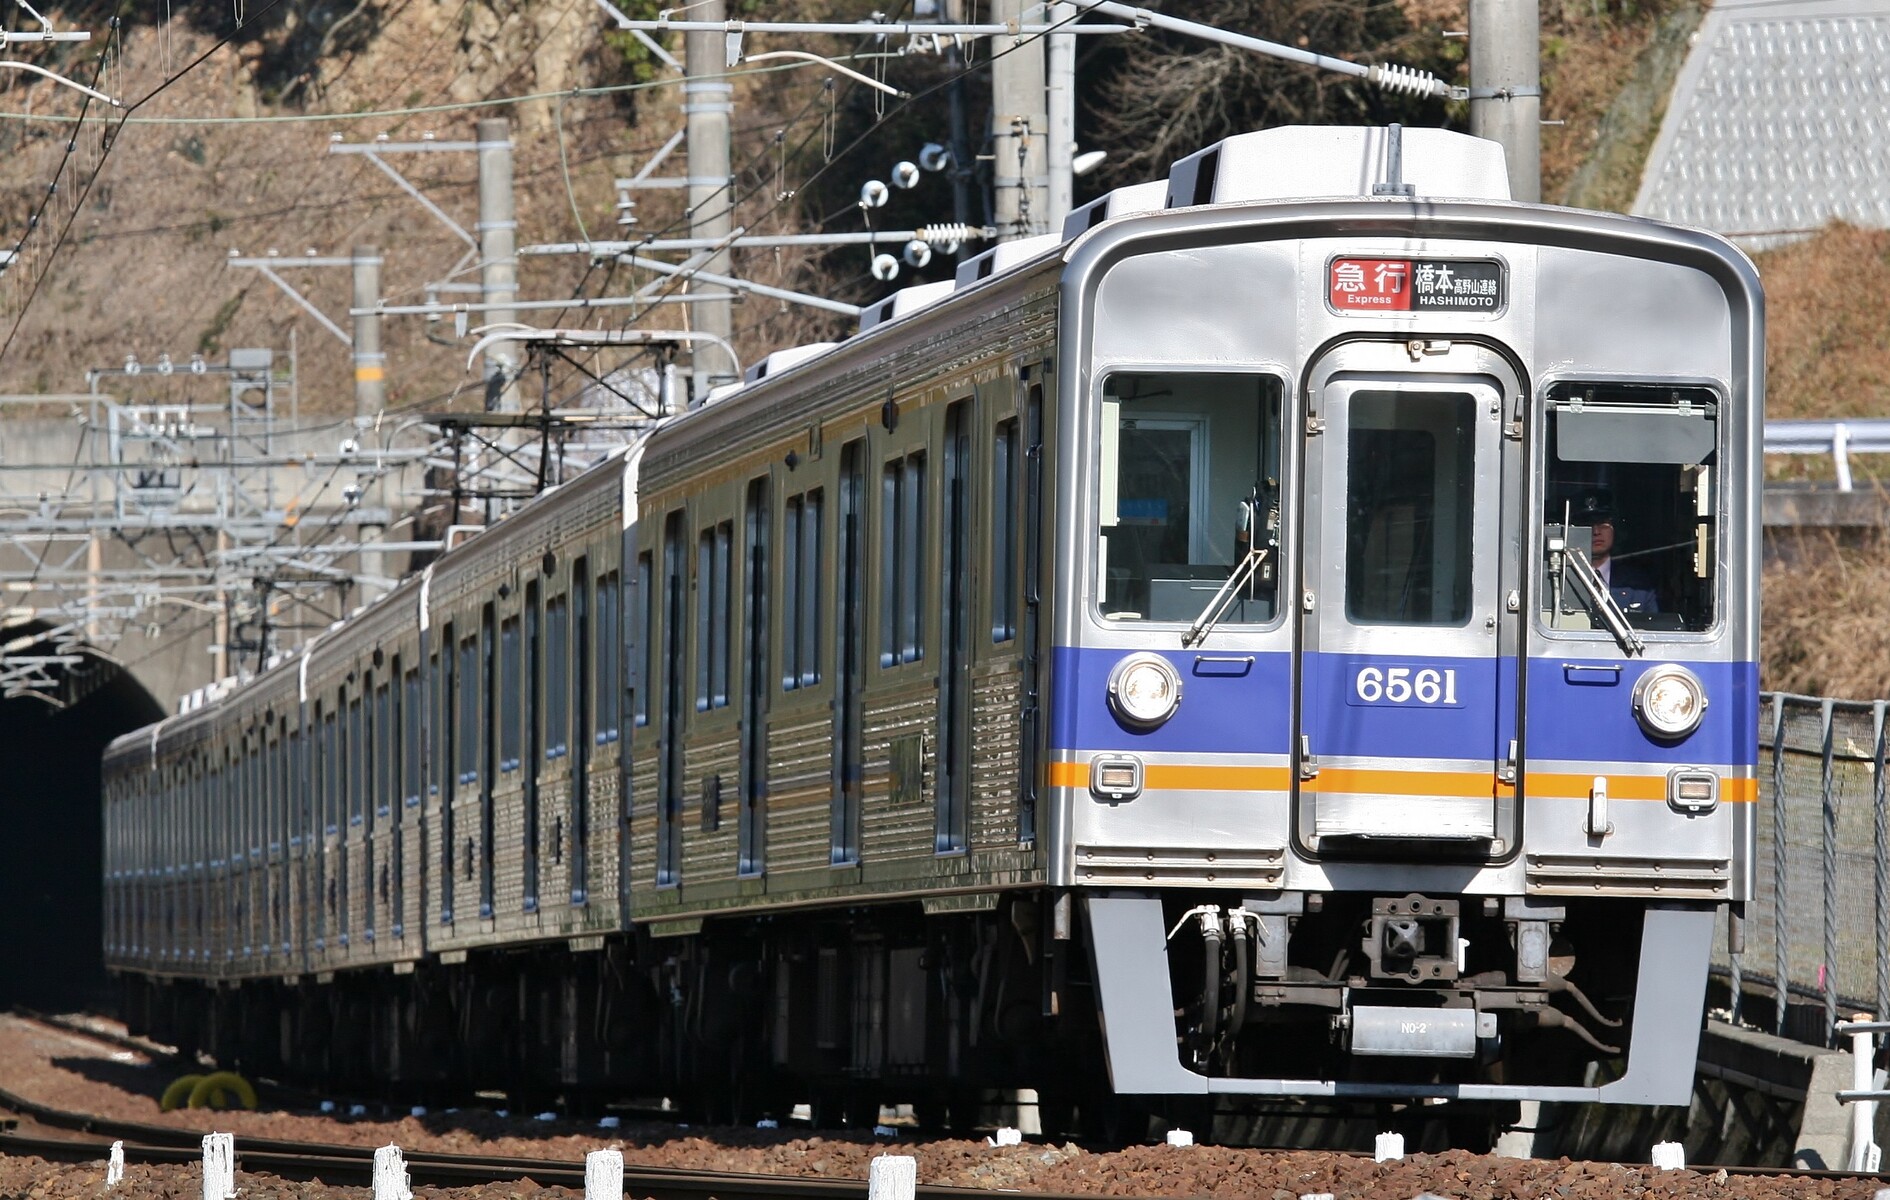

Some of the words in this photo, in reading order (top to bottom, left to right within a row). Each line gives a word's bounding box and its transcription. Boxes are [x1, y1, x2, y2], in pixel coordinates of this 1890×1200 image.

[1334, 262, 1406, 293] 急行
[1415, 264, 1454, 295] 橋本
[1347, 294, 1392, 305] Express
[1419, 295, 1494, 307] HASHIMOTO
[1356, 667, 1457, 704] 6561
